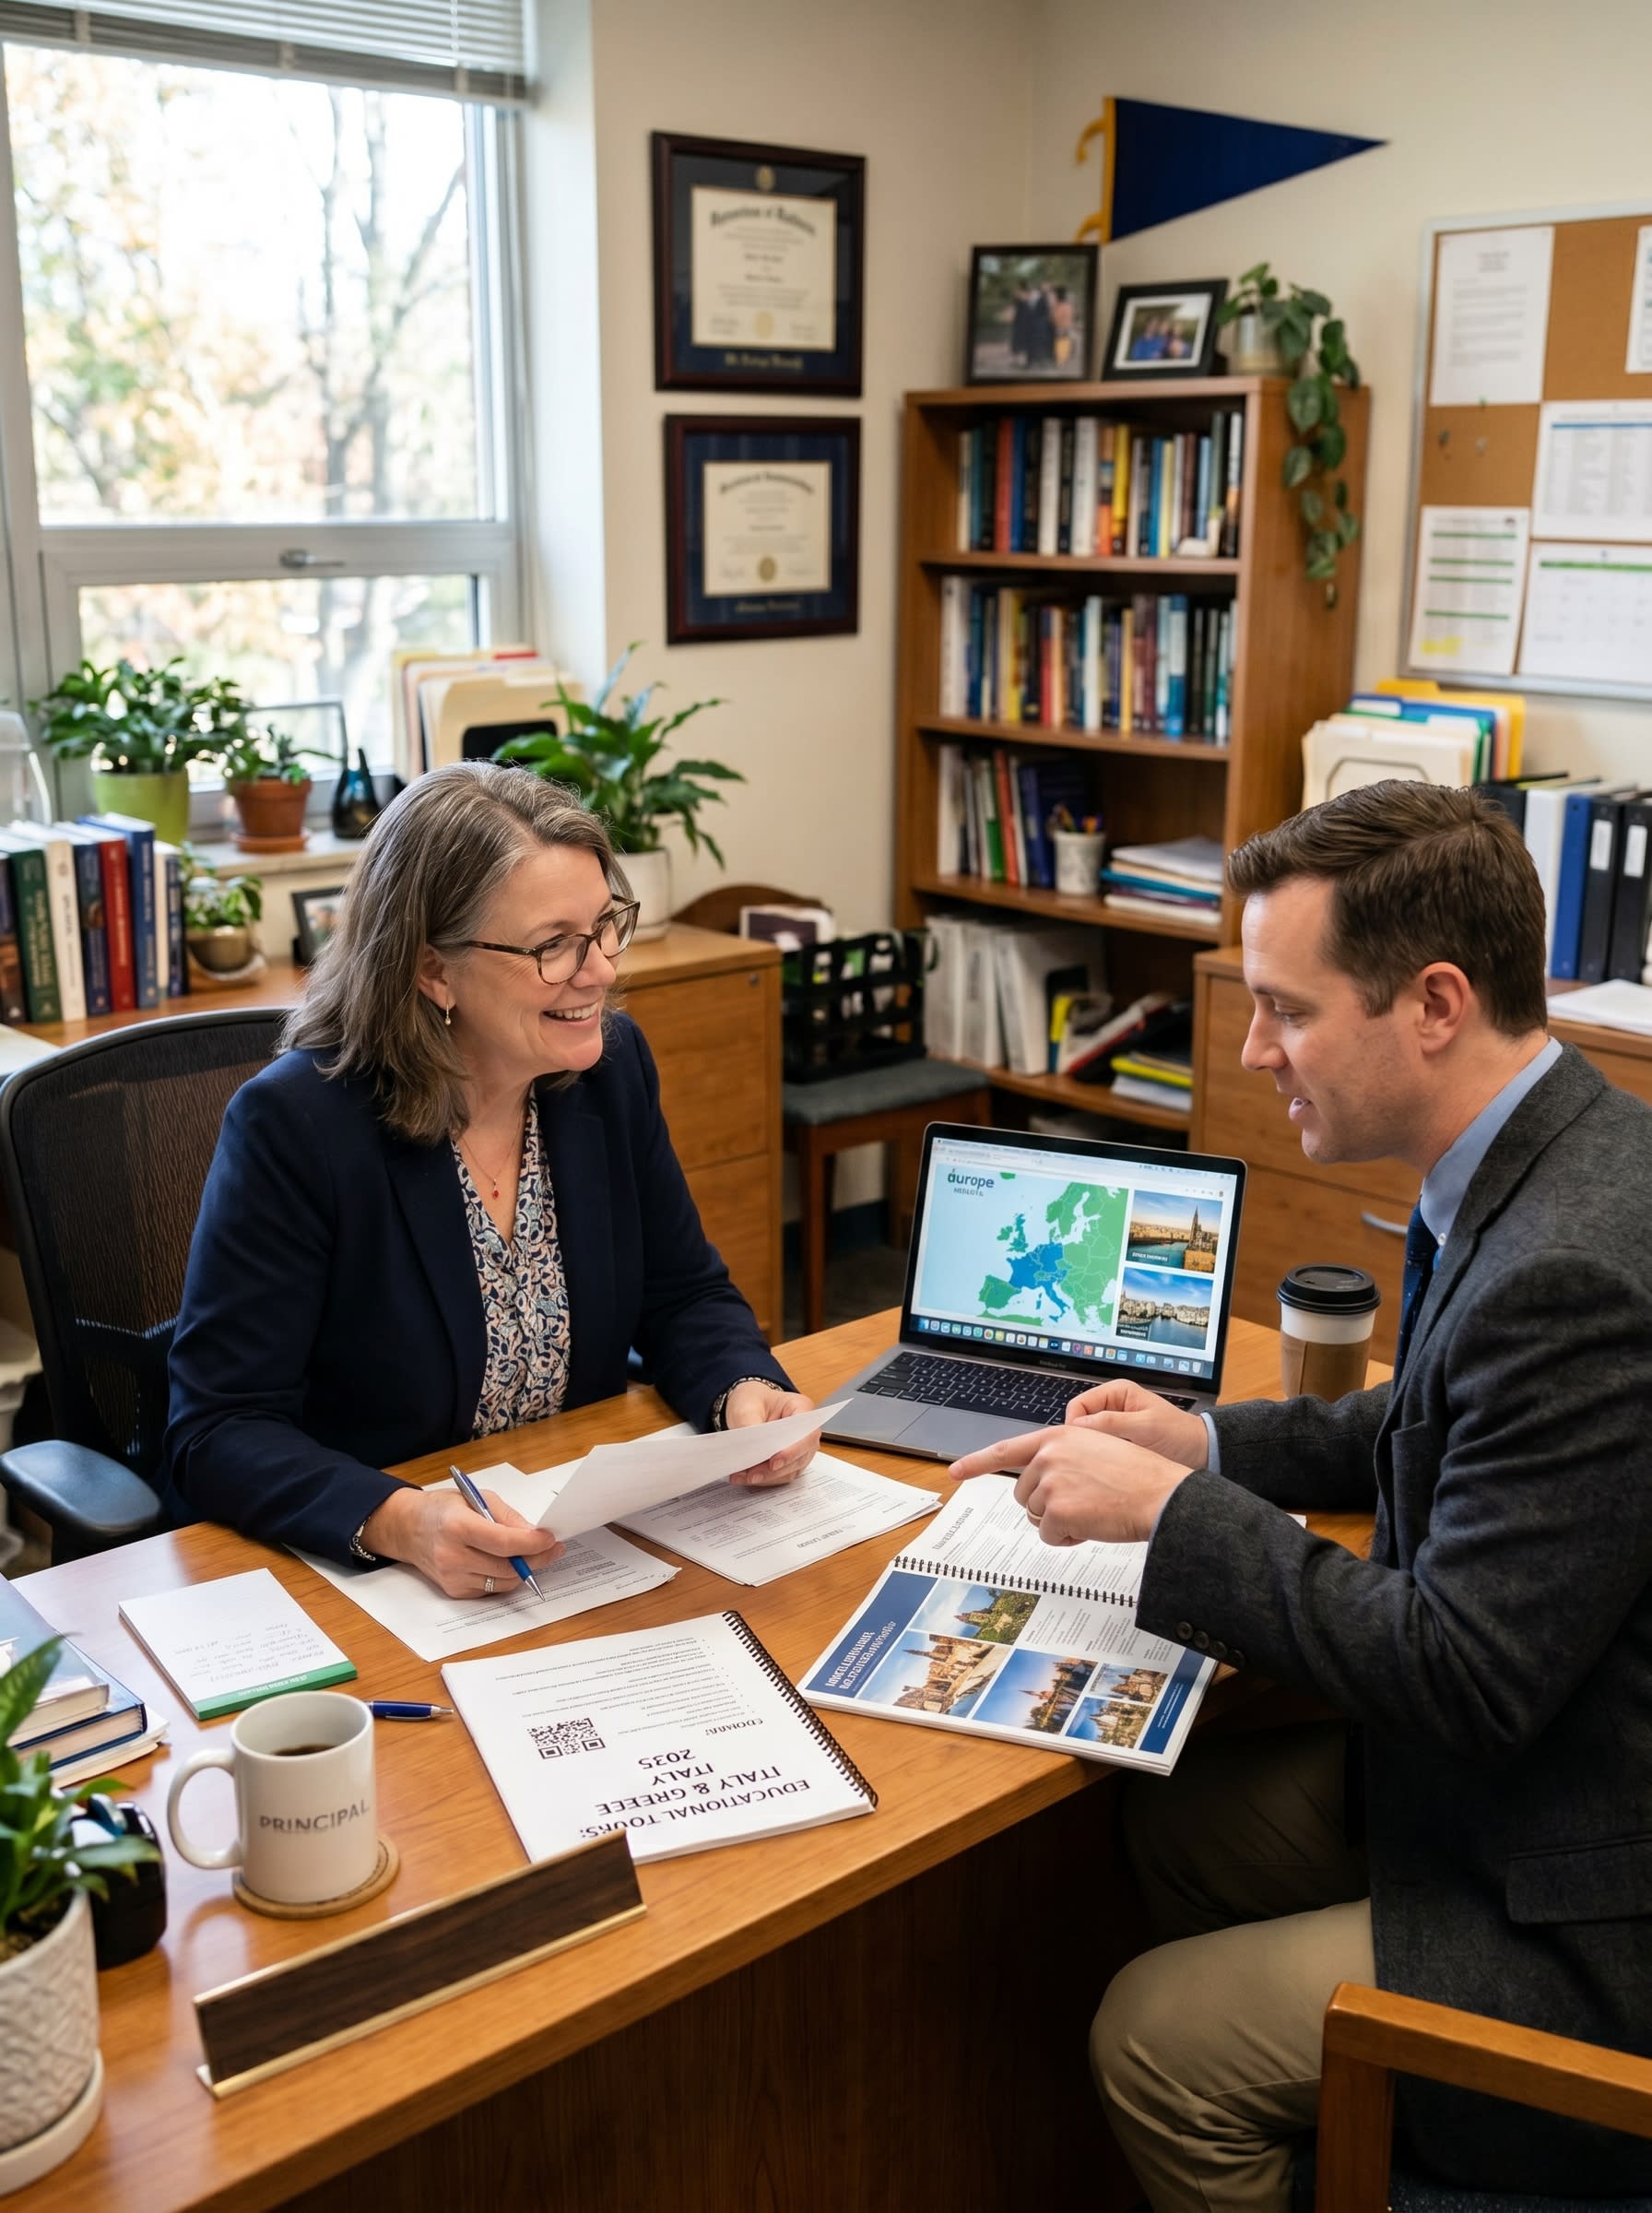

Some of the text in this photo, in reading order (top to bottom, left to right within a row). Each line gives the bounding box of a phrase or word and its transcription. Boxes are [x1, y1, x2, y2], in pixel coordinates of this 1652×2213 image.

[638, 1748, 696, 1769] 2035
[651, 1763, 714, 1785] ITALY
[720, 1766, 782, 1791] ITALY
[662, 1779, 810, 1820] EDUCATIONAL
[693, 1782, 710, 1794] &
[259, 1798, 371, 1830] PRINCIPAL
